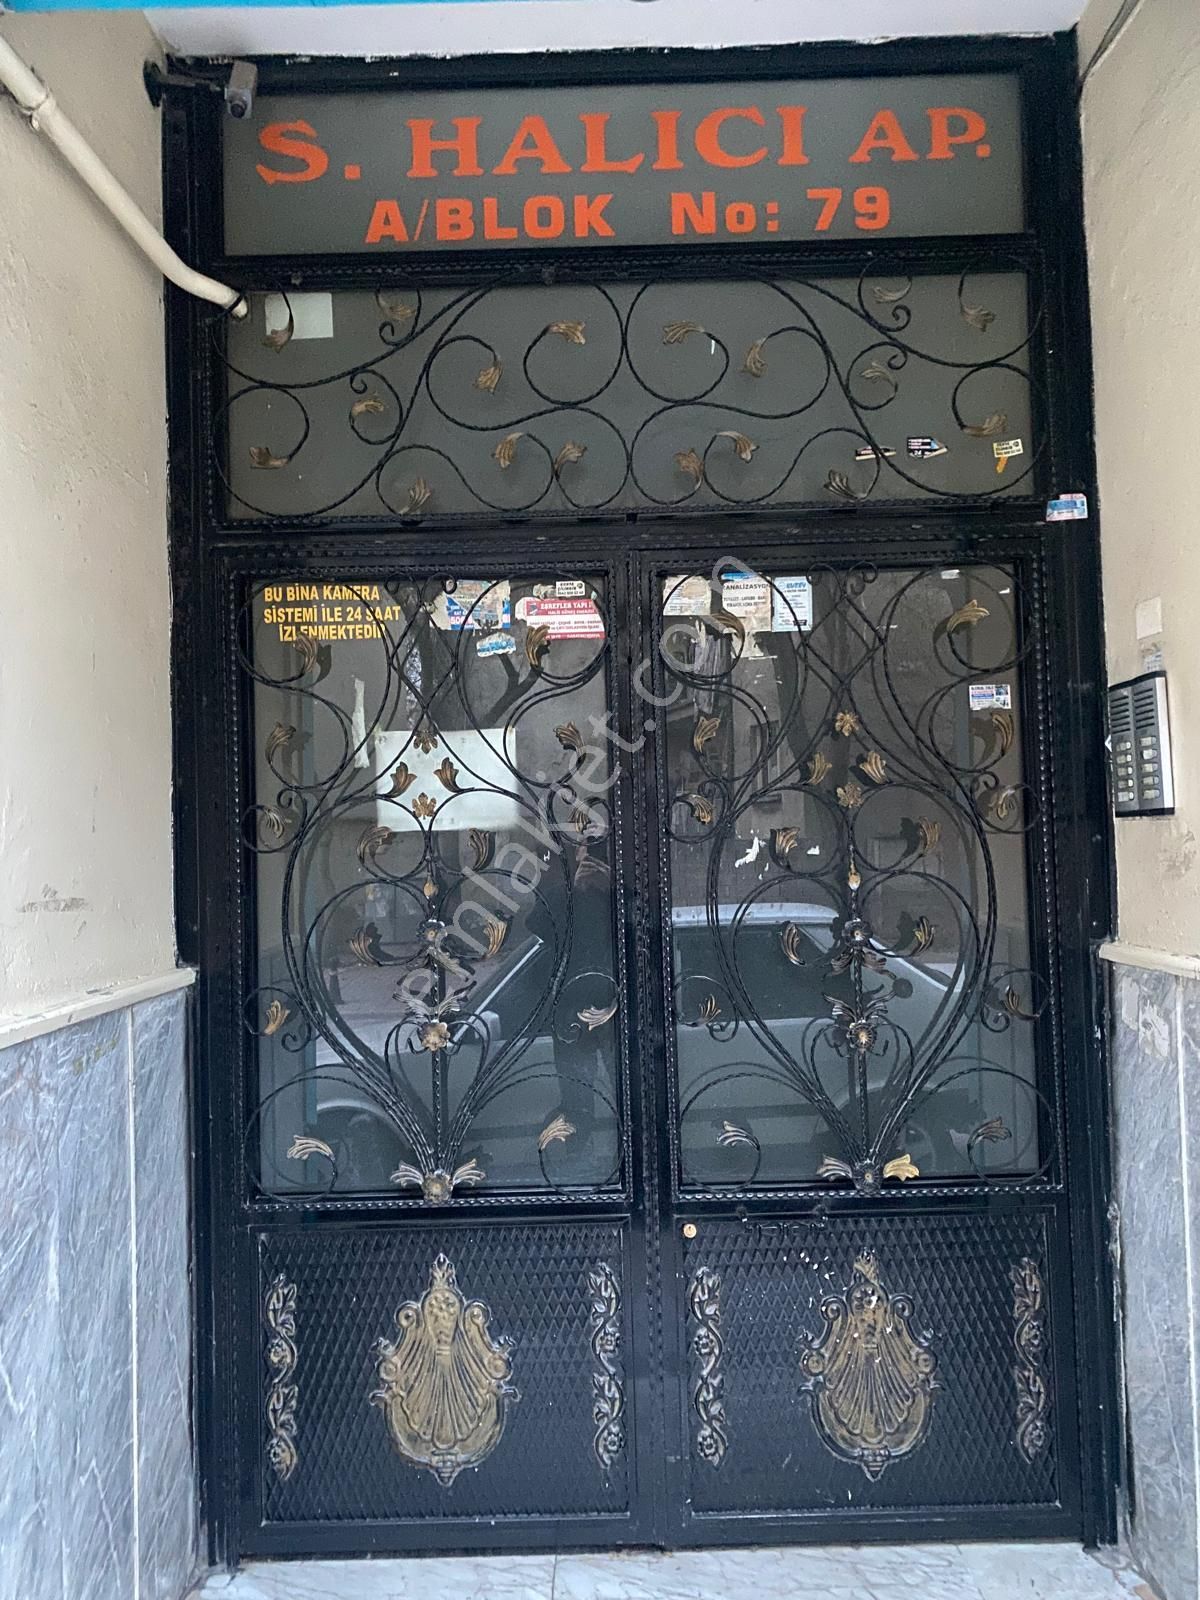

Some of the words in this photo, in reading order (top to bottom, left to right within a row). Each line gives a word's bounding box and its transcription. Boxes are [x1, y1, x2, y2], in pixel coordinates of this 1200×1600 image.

[256, 121, 361, 184] S.
[407, 106, 809, 178] HALICI
[850, 107, 991, 163] AP.
[365, 192, 615, 244] A/BLOK
[671, 190, 780, 235] No:
[807, 187, 891, 231] 79
[264, 587, 282, 602] BU
[287, 583, 319, 601] BİNA
[323, 584, 380, 600] KAMERA
[264, 605, 318, 624] SİSTEMİ
[322, 604, 343, 622] İLE
[346, 606, 362, 622] 24
[366, 605, 401, 622] SAAT
